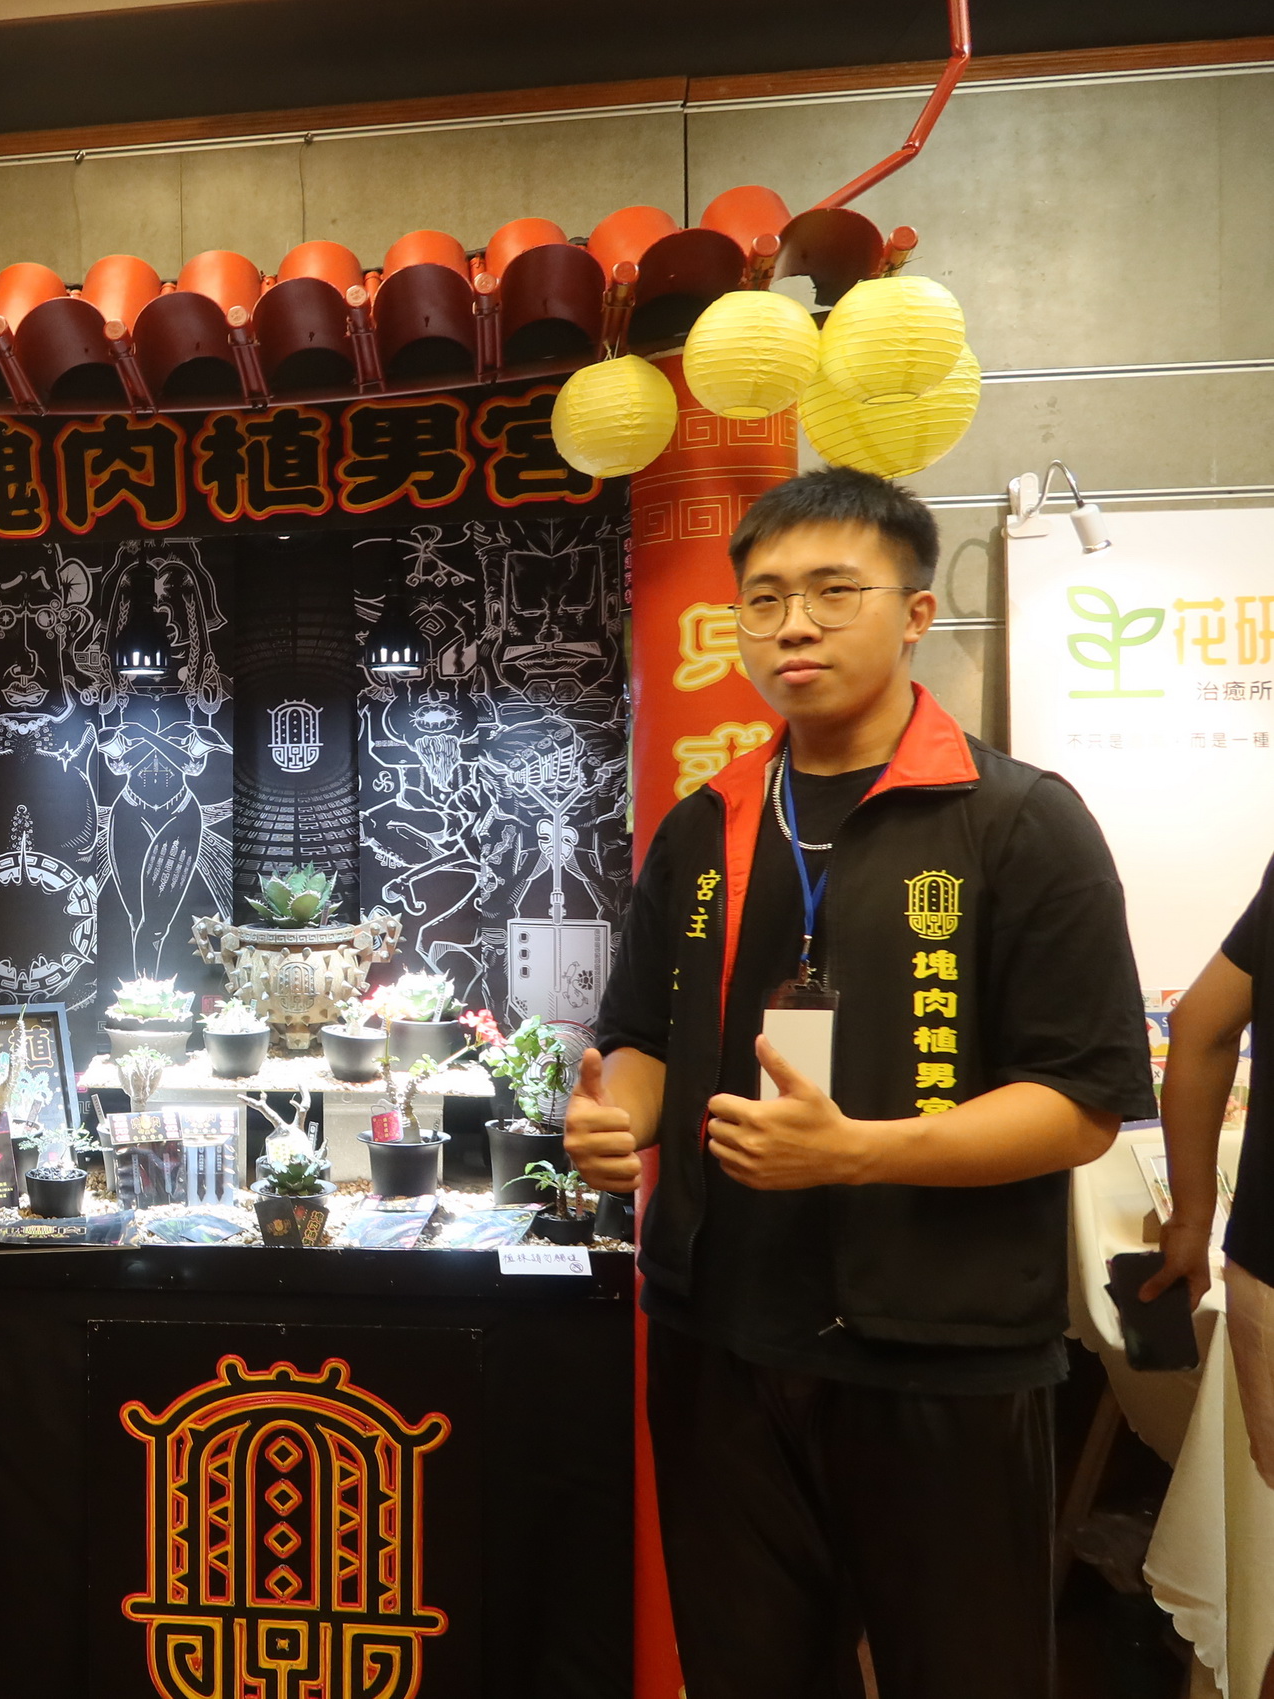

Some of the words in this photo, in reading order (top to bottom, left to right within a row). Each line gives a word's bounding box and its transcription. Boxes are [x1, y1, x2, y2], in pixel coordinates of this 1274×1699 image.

[1197, 680, 1273, 701] 治癒所
[685, 869, 722, 938] 宮主
